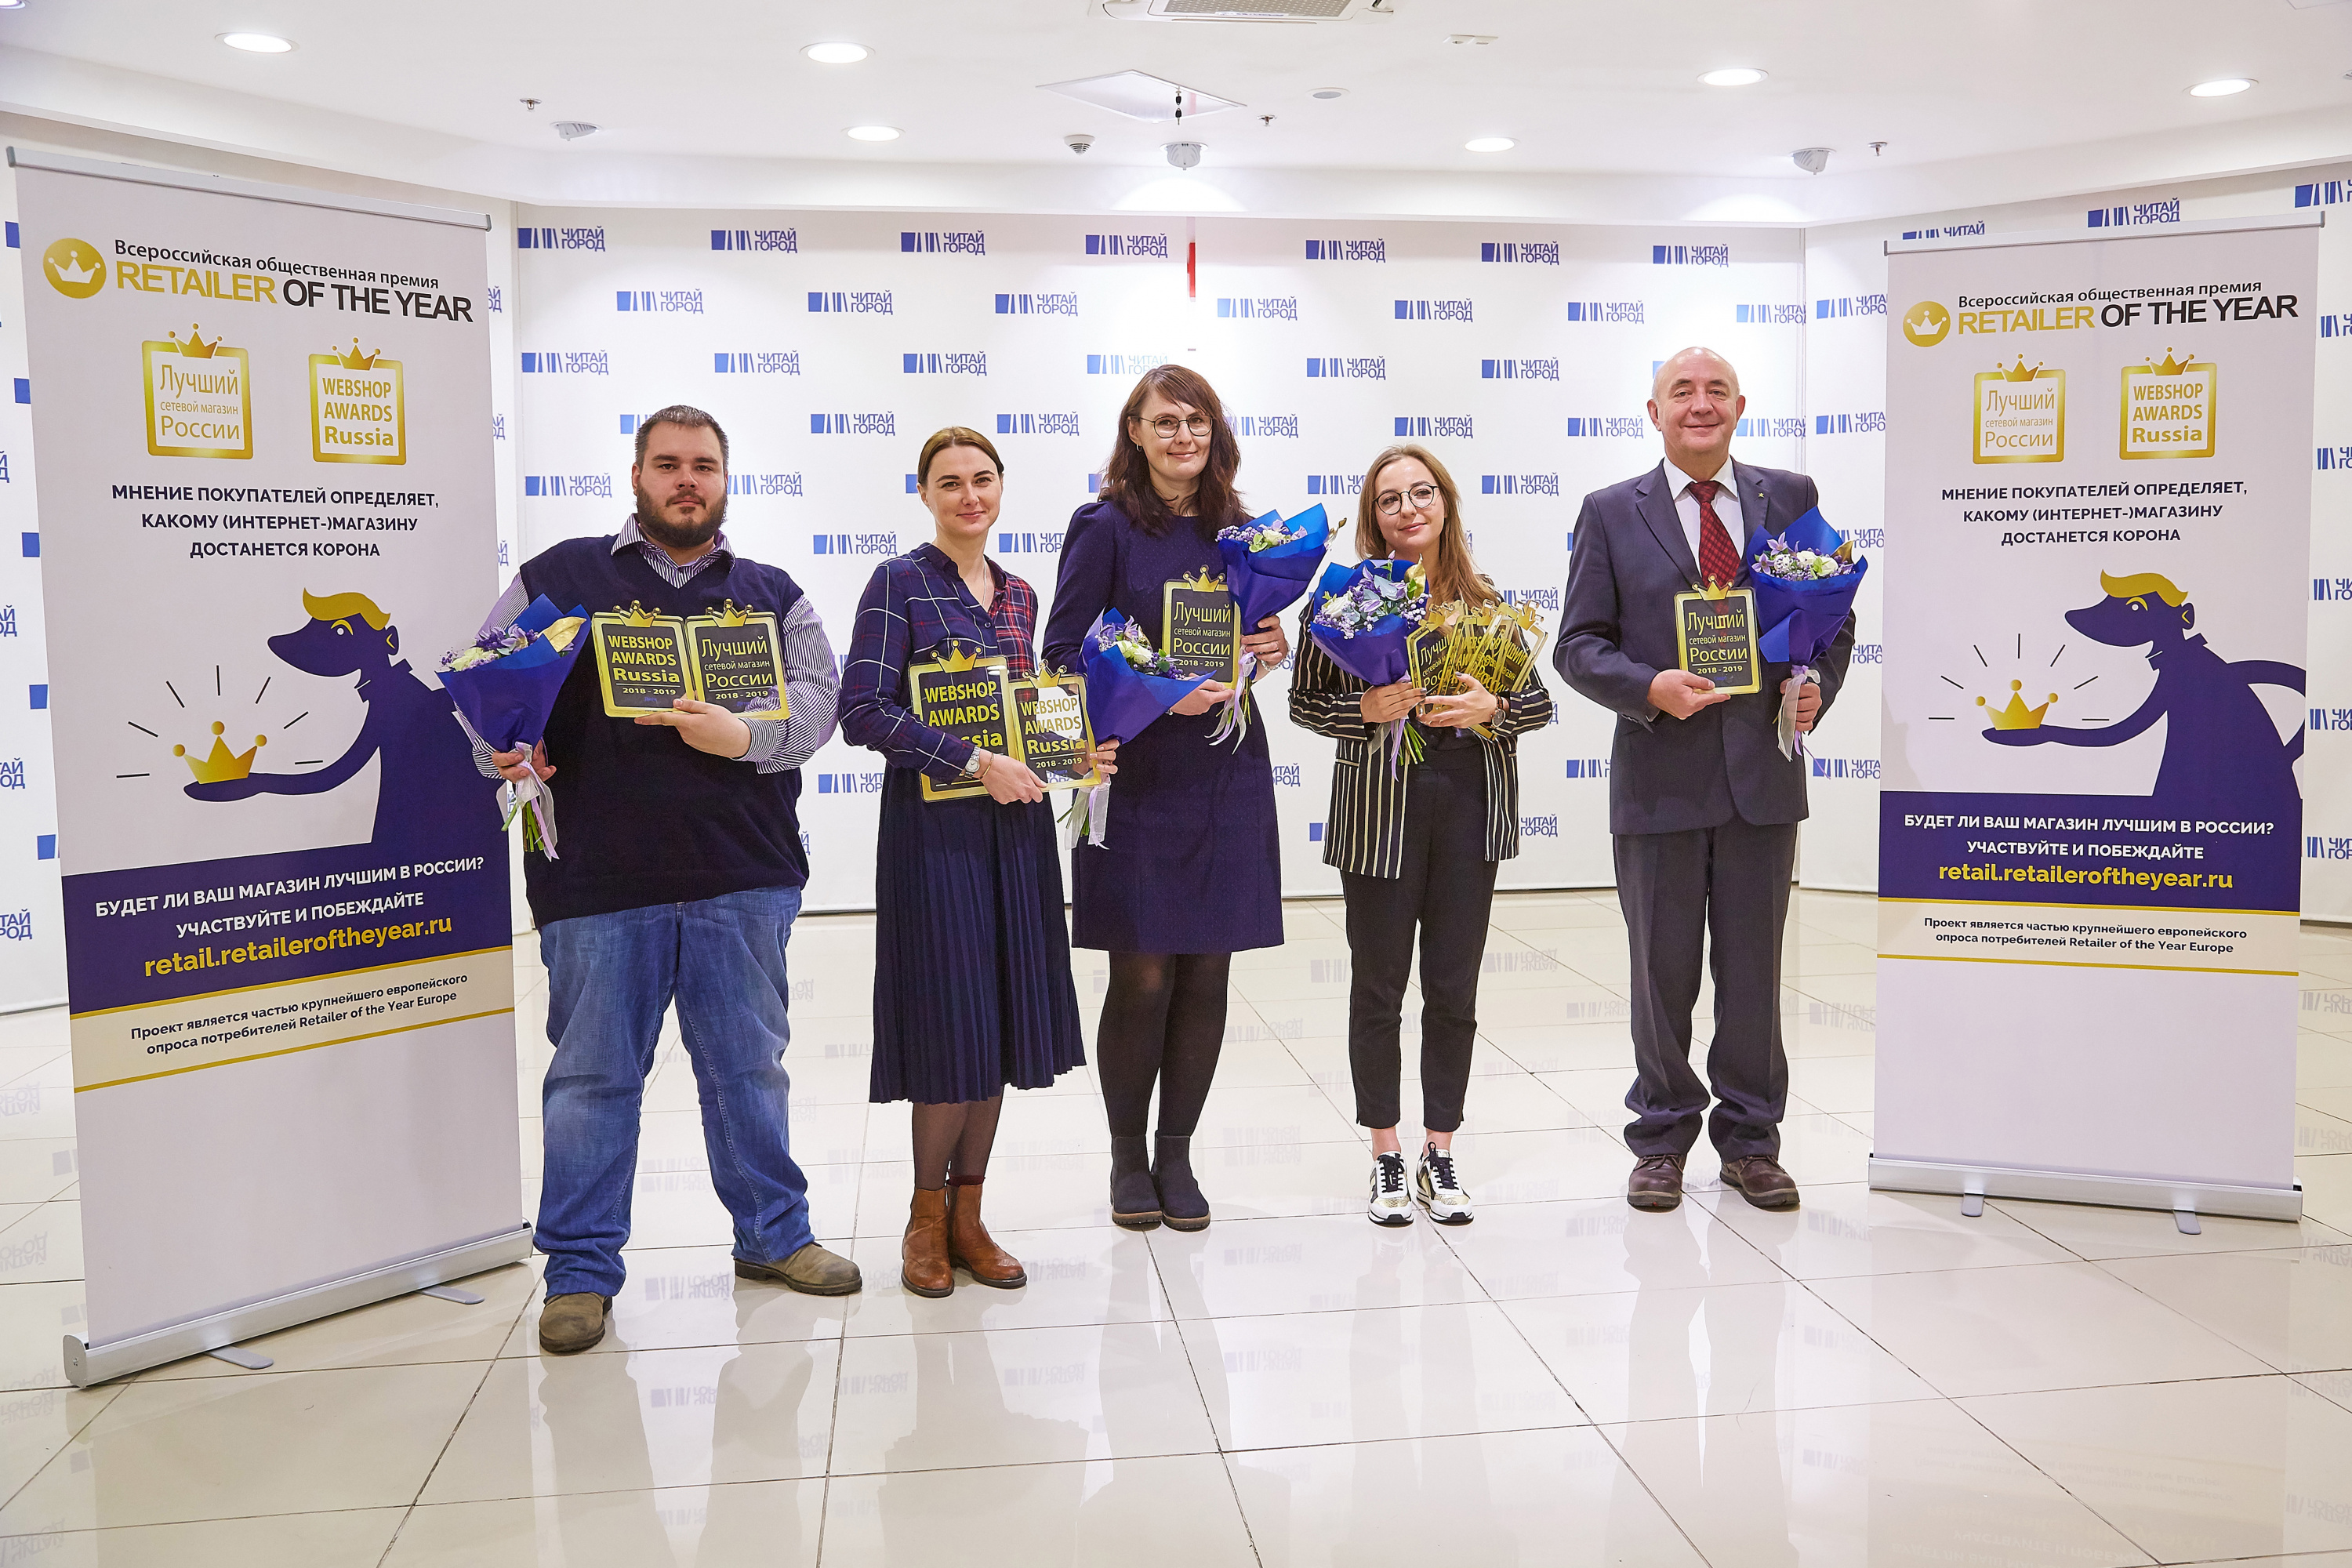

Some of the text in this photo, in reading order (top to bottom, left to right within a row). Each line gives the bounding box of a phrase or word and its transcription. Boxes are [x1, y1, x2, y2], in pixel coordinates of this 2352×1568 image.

[2134, 198, 2180, 215] ЧИТАЙ
[2133, 210, 2180, 225] ГОРОД
[561, 226, 604, 238] ЧИТАЙ
[944, 230, 984, 242] ЧИТАЙ
[562, 238, 605, 252] ГОРОД
[944, 242, 985, 256] ГОРОД
[1521, 241, 1559, 252] ЧИТАЙ
[115, 239, 439, 289] Всероссийская общественная премия
[1521, 252, 1559, 265] ГОРОД
[116, 260, 278, 304] RETAILER
[283, 279, 325, 307] OF
[331, 283, 390, 314] THE
[394, 290, 474, 322] YEAR
[851, 290, 891, 302] ЧИТАЙ
[1959, 282, 2261, 309] Всероссийская общественная премия
[851, 302, 893, 315] ГОРОД
[1435, 298, 1472, 310] ЧИТАЙ
[1435, 310, 1472, 322] ГОРОД
[1959, 295, 2298, 334] RETAILER OF THE YEAR
[946, 351, 985, 363] ЧИТАЙ
[946, 363, 986, 376] ГОРОД
[160, 365, 238, 398] Лучший
[322, 378, 391, 398] WEBSHOP
[2133, 383, 2203, 401] WEBSHOP
[161, 401, 238, 415] сетевой магазин
[1987, 388, 2054, 417] Лучший
[325, 402, 392, 422] AWARDS
[854, 411, 894, 423] ЧИТАЙ
[1259, 414, 1297, 426] ЧИТАЙ
[2133, 405, 2202, 421] AWARDS
[162, 416, 239, 439] России
[854, 423, 895, 436] ГОРОД
[1986, 417, 2017, 427] сетевой
[325, 426, 393, 446] Russia
[1259, 426, 1298, 438] ГОРОД
[1986, 431, 2053, 448] России
[2132, 425, 2201, 443] Russia
[570, 473, 610, 485] ЧИТАЙ
[1521, 473, 1558, 484] ЧИТАЙ
[112, 485, 438, 508] МНЕНИЕ ПОКУПАТЕЛЕЙ ОПРЕДЕЛЯЕТ,
[570, 485, 612, 498] ГОРОД
[1521, 484, 1559, 496] ГОРОД
[1943, 481, 2246, 500] МНЕНИЕ ПОКУПАТЕЛЕЙ ОПРЕДЕЛЯЕТ,
[142, 514, 218, 528] КАКОМУ
[1964, 510, 2029, 521] КАКОМУ
[856, 532, 896, 543] ЧИТАЙ
[2002, 529, 2180, 546] ДОСТАНЕТСЯ КОРОНА
[191, 543, 379, 558] ДОСТАНЕТСЯ КОРОНА
[856, 543, 898, 557] ГОРОД
[1174, 602, 1231, 626] Лучший
[1688, 609, 1744, 634] Лучший
[1174, 627, 1231, 637] сетевой магазин
[1690, 635, 1716, 644] сетевой
[608, 636, 672, 649] WEBSHOP
[702, 636, 767, 662] Лучший
[1174, 638, 1229, 655] России
[612, 652, 676, 666] AWARDS
[1690, 648, 1747, 662] России
[705, 661, 736, 670] сетевой
[613, 668, 680, 682] Russia
[706, 673, 772, 688] России
[924, 681, 997, 703] WEBSHOP
[1021, 698, 1078, 716] WEBSHOP
[929, 704, 1000, 727] AWARDS
[1025, 716, 1082, 735] AWARDS
[1027, 735, 1086, 754] Russia
[1905, 815, 2274, 834] БУДЕТ ЛИ ВАШ МАГАЗИН ЛУЧШИМ В РОССИИ?
[1967, 840, 2203, 860] УЧАСТВУЙТЕ И ПОБЕЖДАЙТЕ
[1940, 863, 2232, 891] retail.retaileroftheyear.ru
[96, 857, 483, 916] БУДЕТ ЛИ ВАШ МАГАЗИН ЛУЧШИМ В РОССИИ?
[176, 891, 423, 938] УЧАСТВУЙТЕ И ПОБЕЖДАЙТЕ
[1925, 918, 1967, 928] Проект
[2073, 925, 2154, 935] крупнейшего
[2158, 928, 2247, 938] европейского
[145, 918, 452, 976] retail.retaileroftheyear.ru
[1936, 935, 1978, 943] опроса
[1982, 935, 2066, 946] потребителей
[2070, 938, 2117, 947] Retailer
[2136, 940, 2154, 949] the
[2158, 941, 2186, 950] Year
[2190, 942, 2234, 954] Europe
[132, 975, 467, 1040] Проект является частью крупнейшего европейского
[147, 993, 456, 1054] опроса потребителей Retailer of the Year Europe
